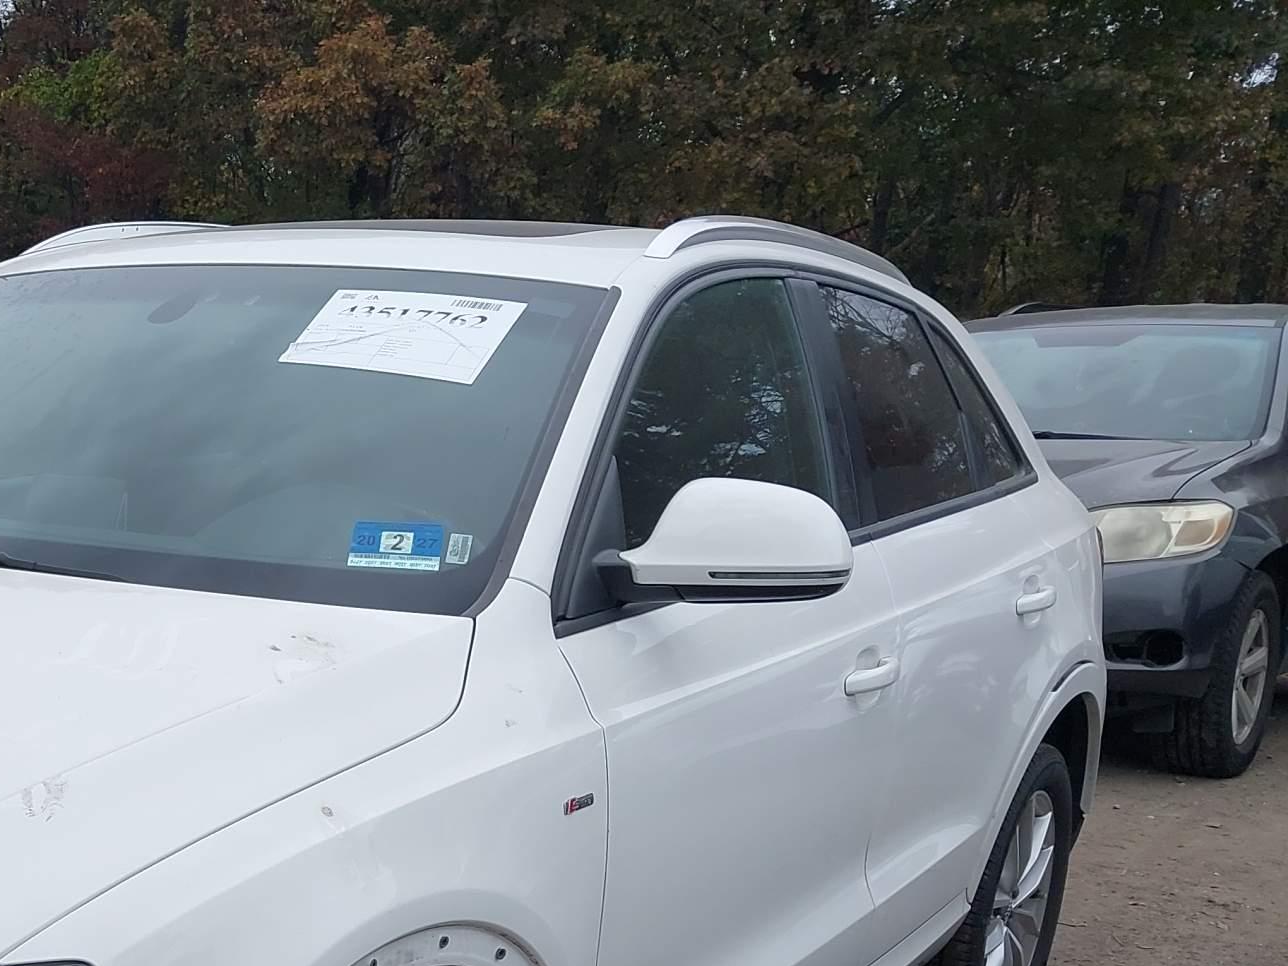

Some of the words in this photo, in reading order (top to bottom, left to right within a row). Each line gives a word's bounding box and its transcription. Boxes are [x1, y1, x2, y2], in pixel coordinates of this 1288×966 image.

[338, 305, 488, 329] 43517762
[357, 534, 376, 546] 20
[390, 533, 405, 551] 2
